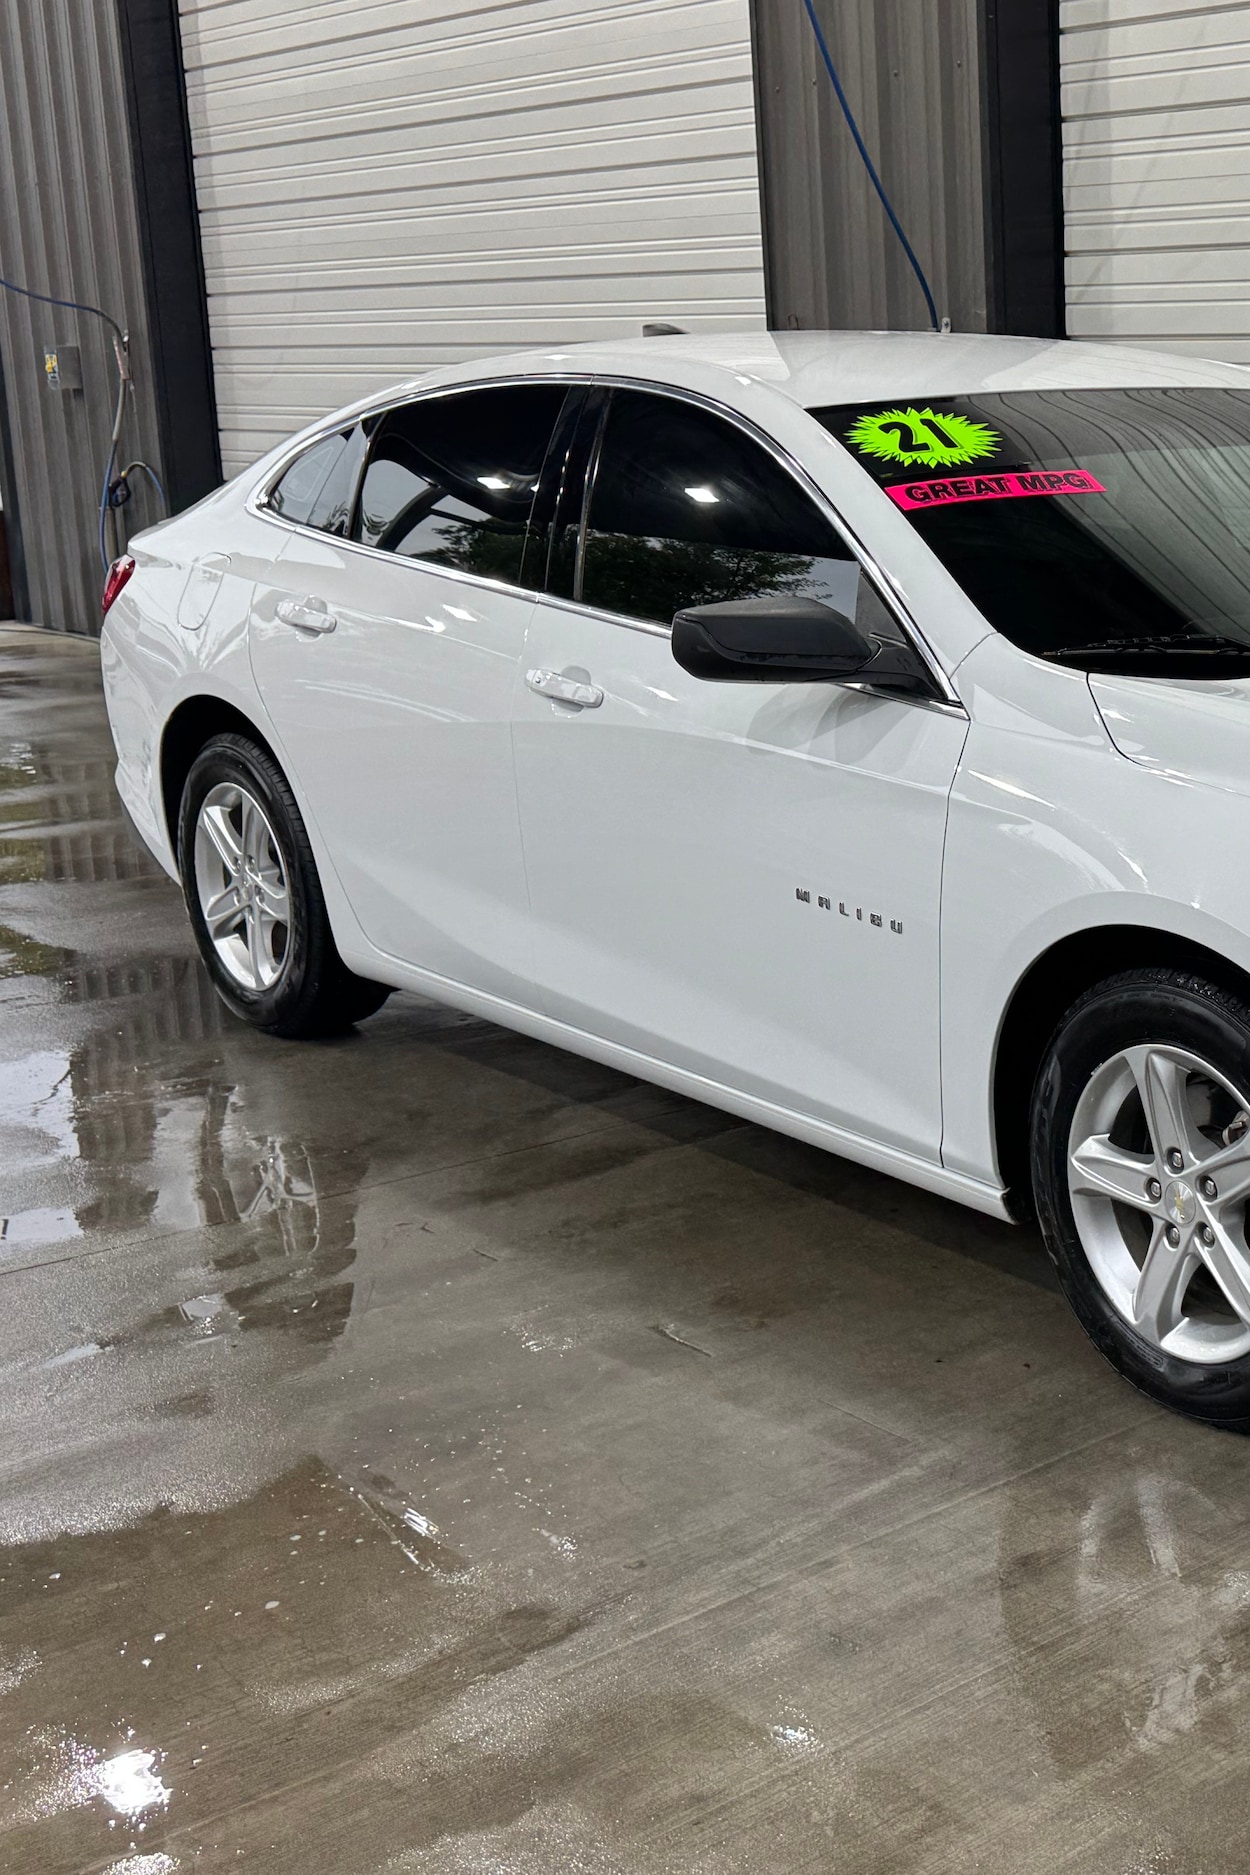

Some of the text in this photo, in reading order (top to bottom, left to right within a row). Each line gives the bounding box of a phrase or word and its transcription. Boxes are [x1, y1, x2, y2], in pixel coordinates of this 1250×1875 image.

[878, 418, 961, 454] 21
[905, 473, 1092, 503] GREAT MPG
[795, 887, 903, 934] MALIBU
